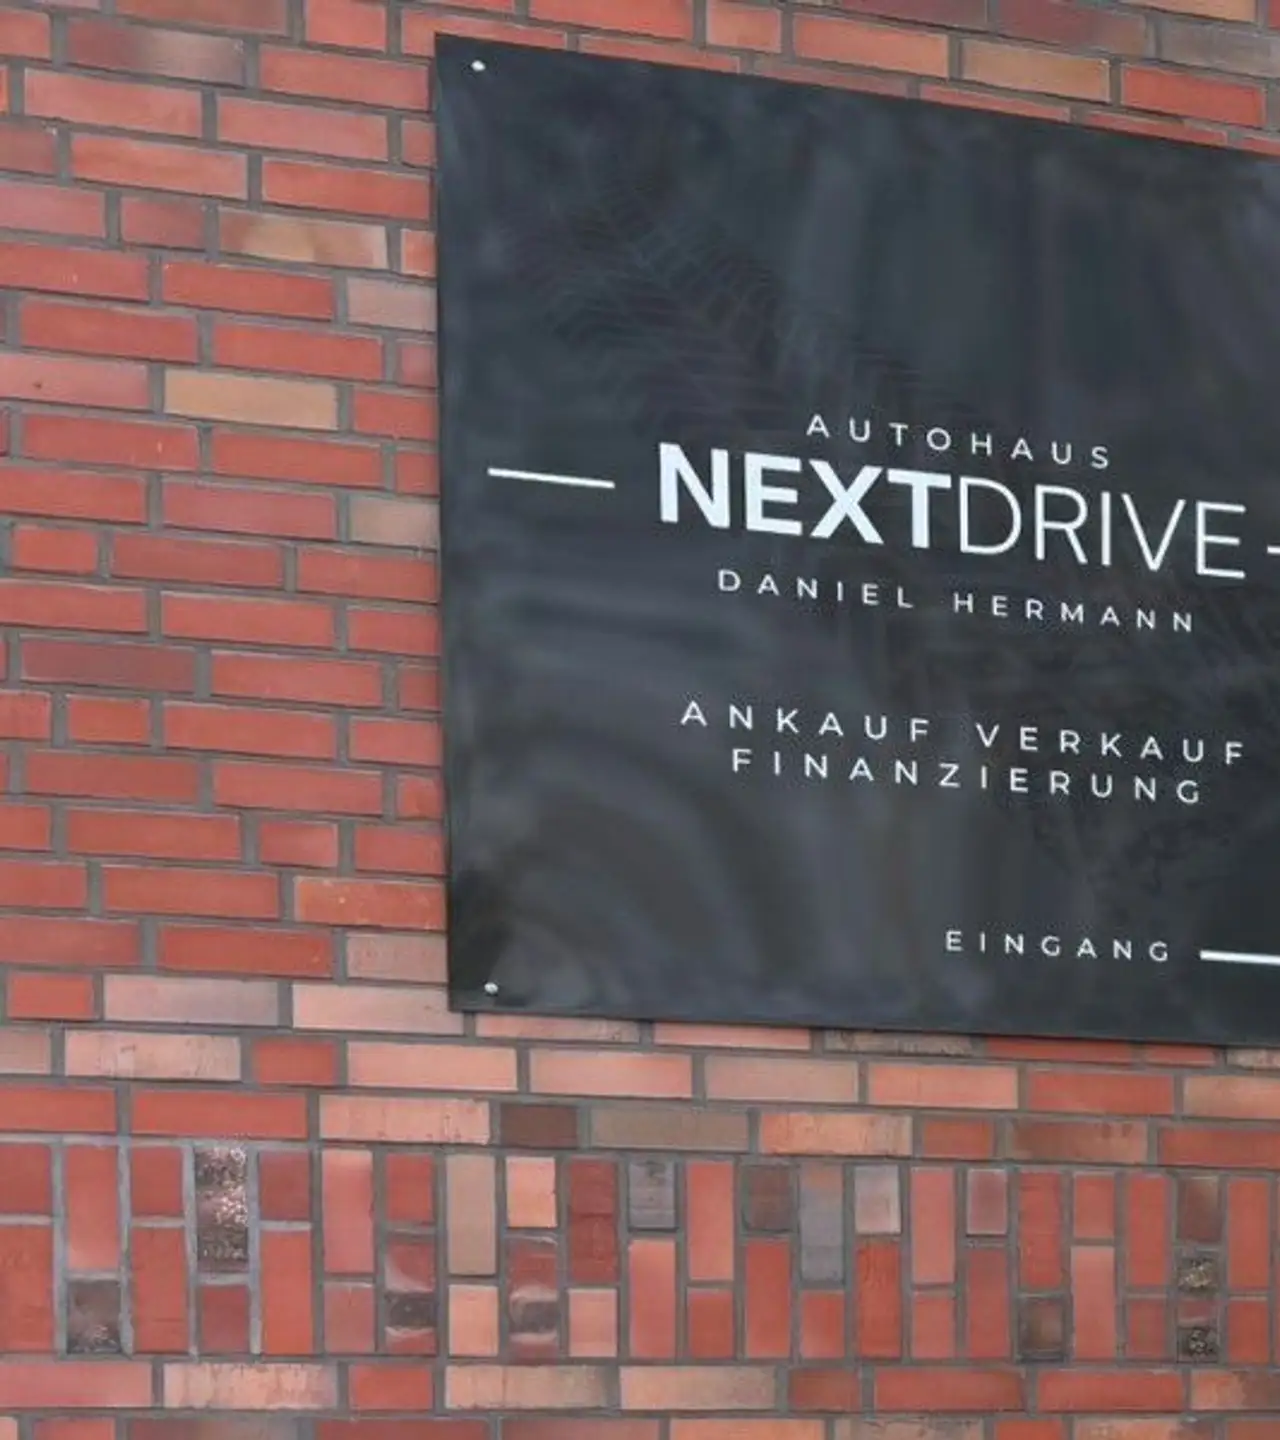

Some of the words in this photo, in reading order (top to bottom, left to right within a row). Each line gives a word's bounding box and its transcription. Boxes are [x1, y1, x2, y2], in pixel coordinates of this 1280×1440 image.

[806, 414, 1110, 469] AUTOHAUS
[659, 441, 1246, 579] NEXTDRIVE
[718, 568, 913, 609] DANIEL
[953, 592, 1192, 632] HERMANN
[680, 700, 929, 743] ANKAUF
[975, 723, 1243, 765] VERKAUF
[732, 748, 1199, 804] FINANZIERUNG
[945, 929, 1168, 962] EINGANG
